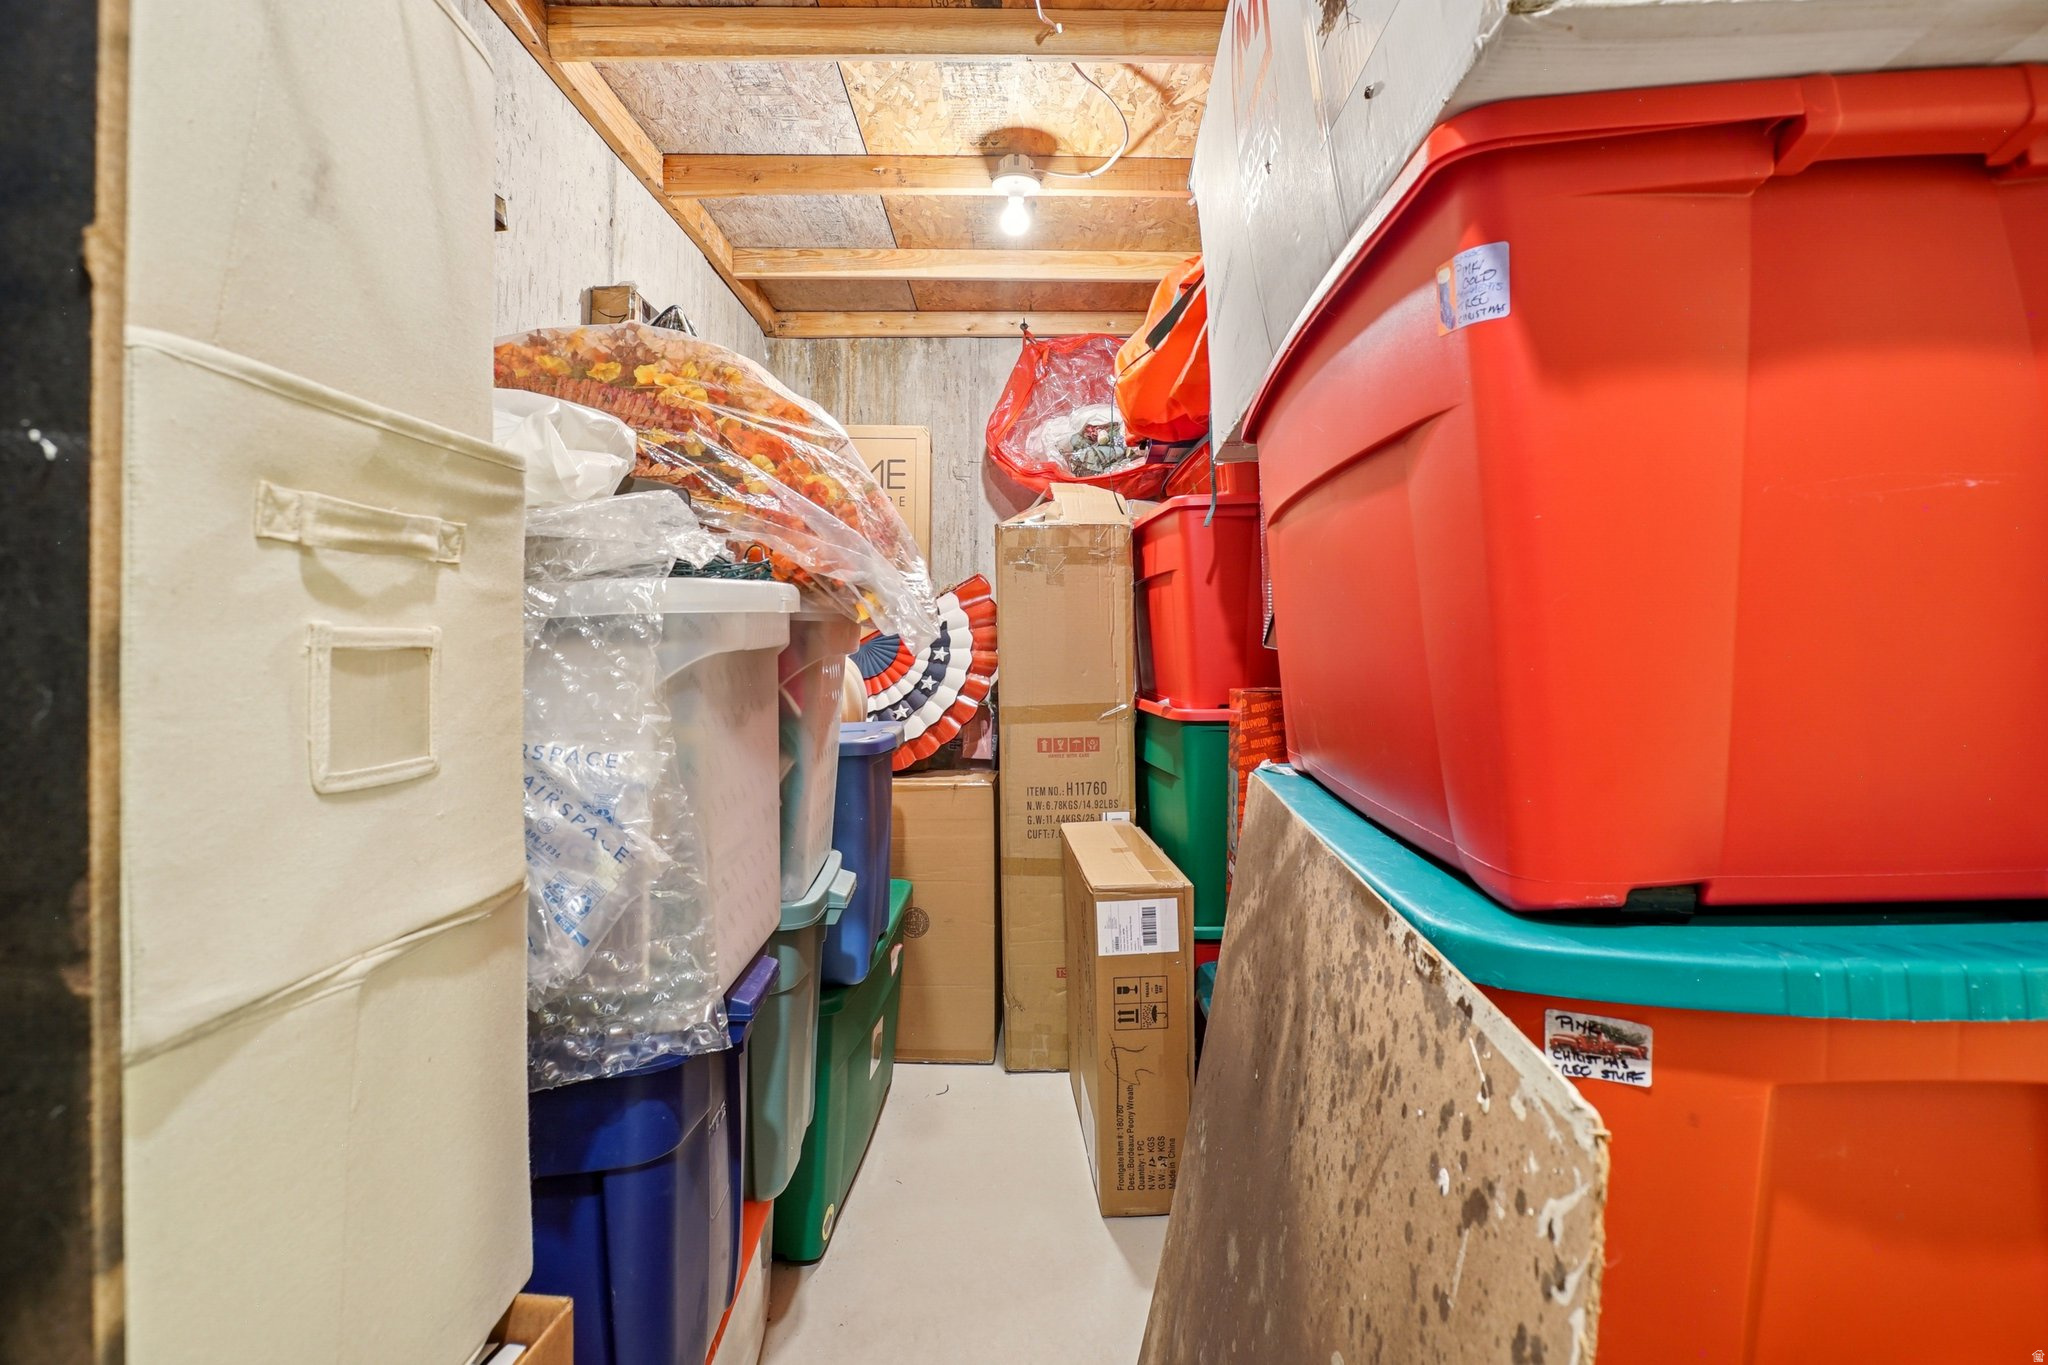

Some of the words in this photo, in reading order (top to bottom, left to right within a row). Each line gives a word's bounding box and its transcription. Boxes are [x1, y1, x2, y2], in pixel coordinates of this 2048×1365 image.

[1026, 787, 1046, 796] ITEM
[1066, 781, 1107, 796] H11760
[524, 775, 630, 864] AIRSPACE
[1127, 1111, 1136, 1133] Peony
[1137, 1140, 1144, 1151] PC
[1168, 1137, 1176, 1159] China
[1138, 1158, 1146, 1190] Quantity:
